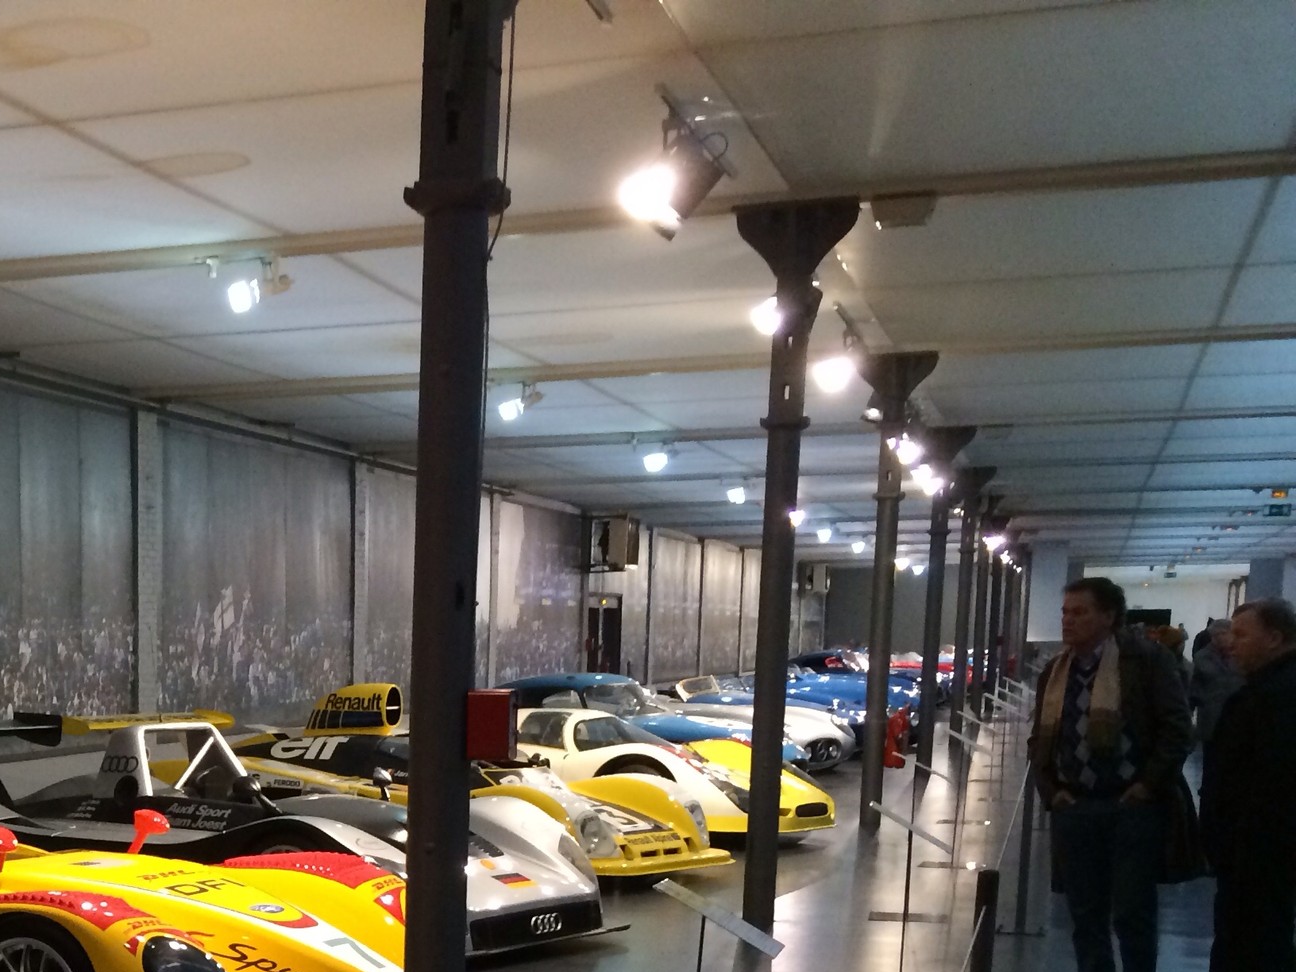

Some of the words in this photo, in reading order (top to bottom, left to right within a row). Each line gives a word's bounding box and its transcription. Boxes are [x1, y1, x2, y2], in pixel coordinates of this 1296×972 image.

[325, 693, 382, 710] Renault
[274, 779, 301, 787] FERODO
[167, 803, 195, 814] Audi
[195, 804, 232, 818] Sport
[191, 816, 228, 830] Joest
[138, 869, 195, 881] DHL
[166, 878, 245, 896] DFI
[371, 878, 402, 890] DHL
[323, 937, 386, 969] 7
